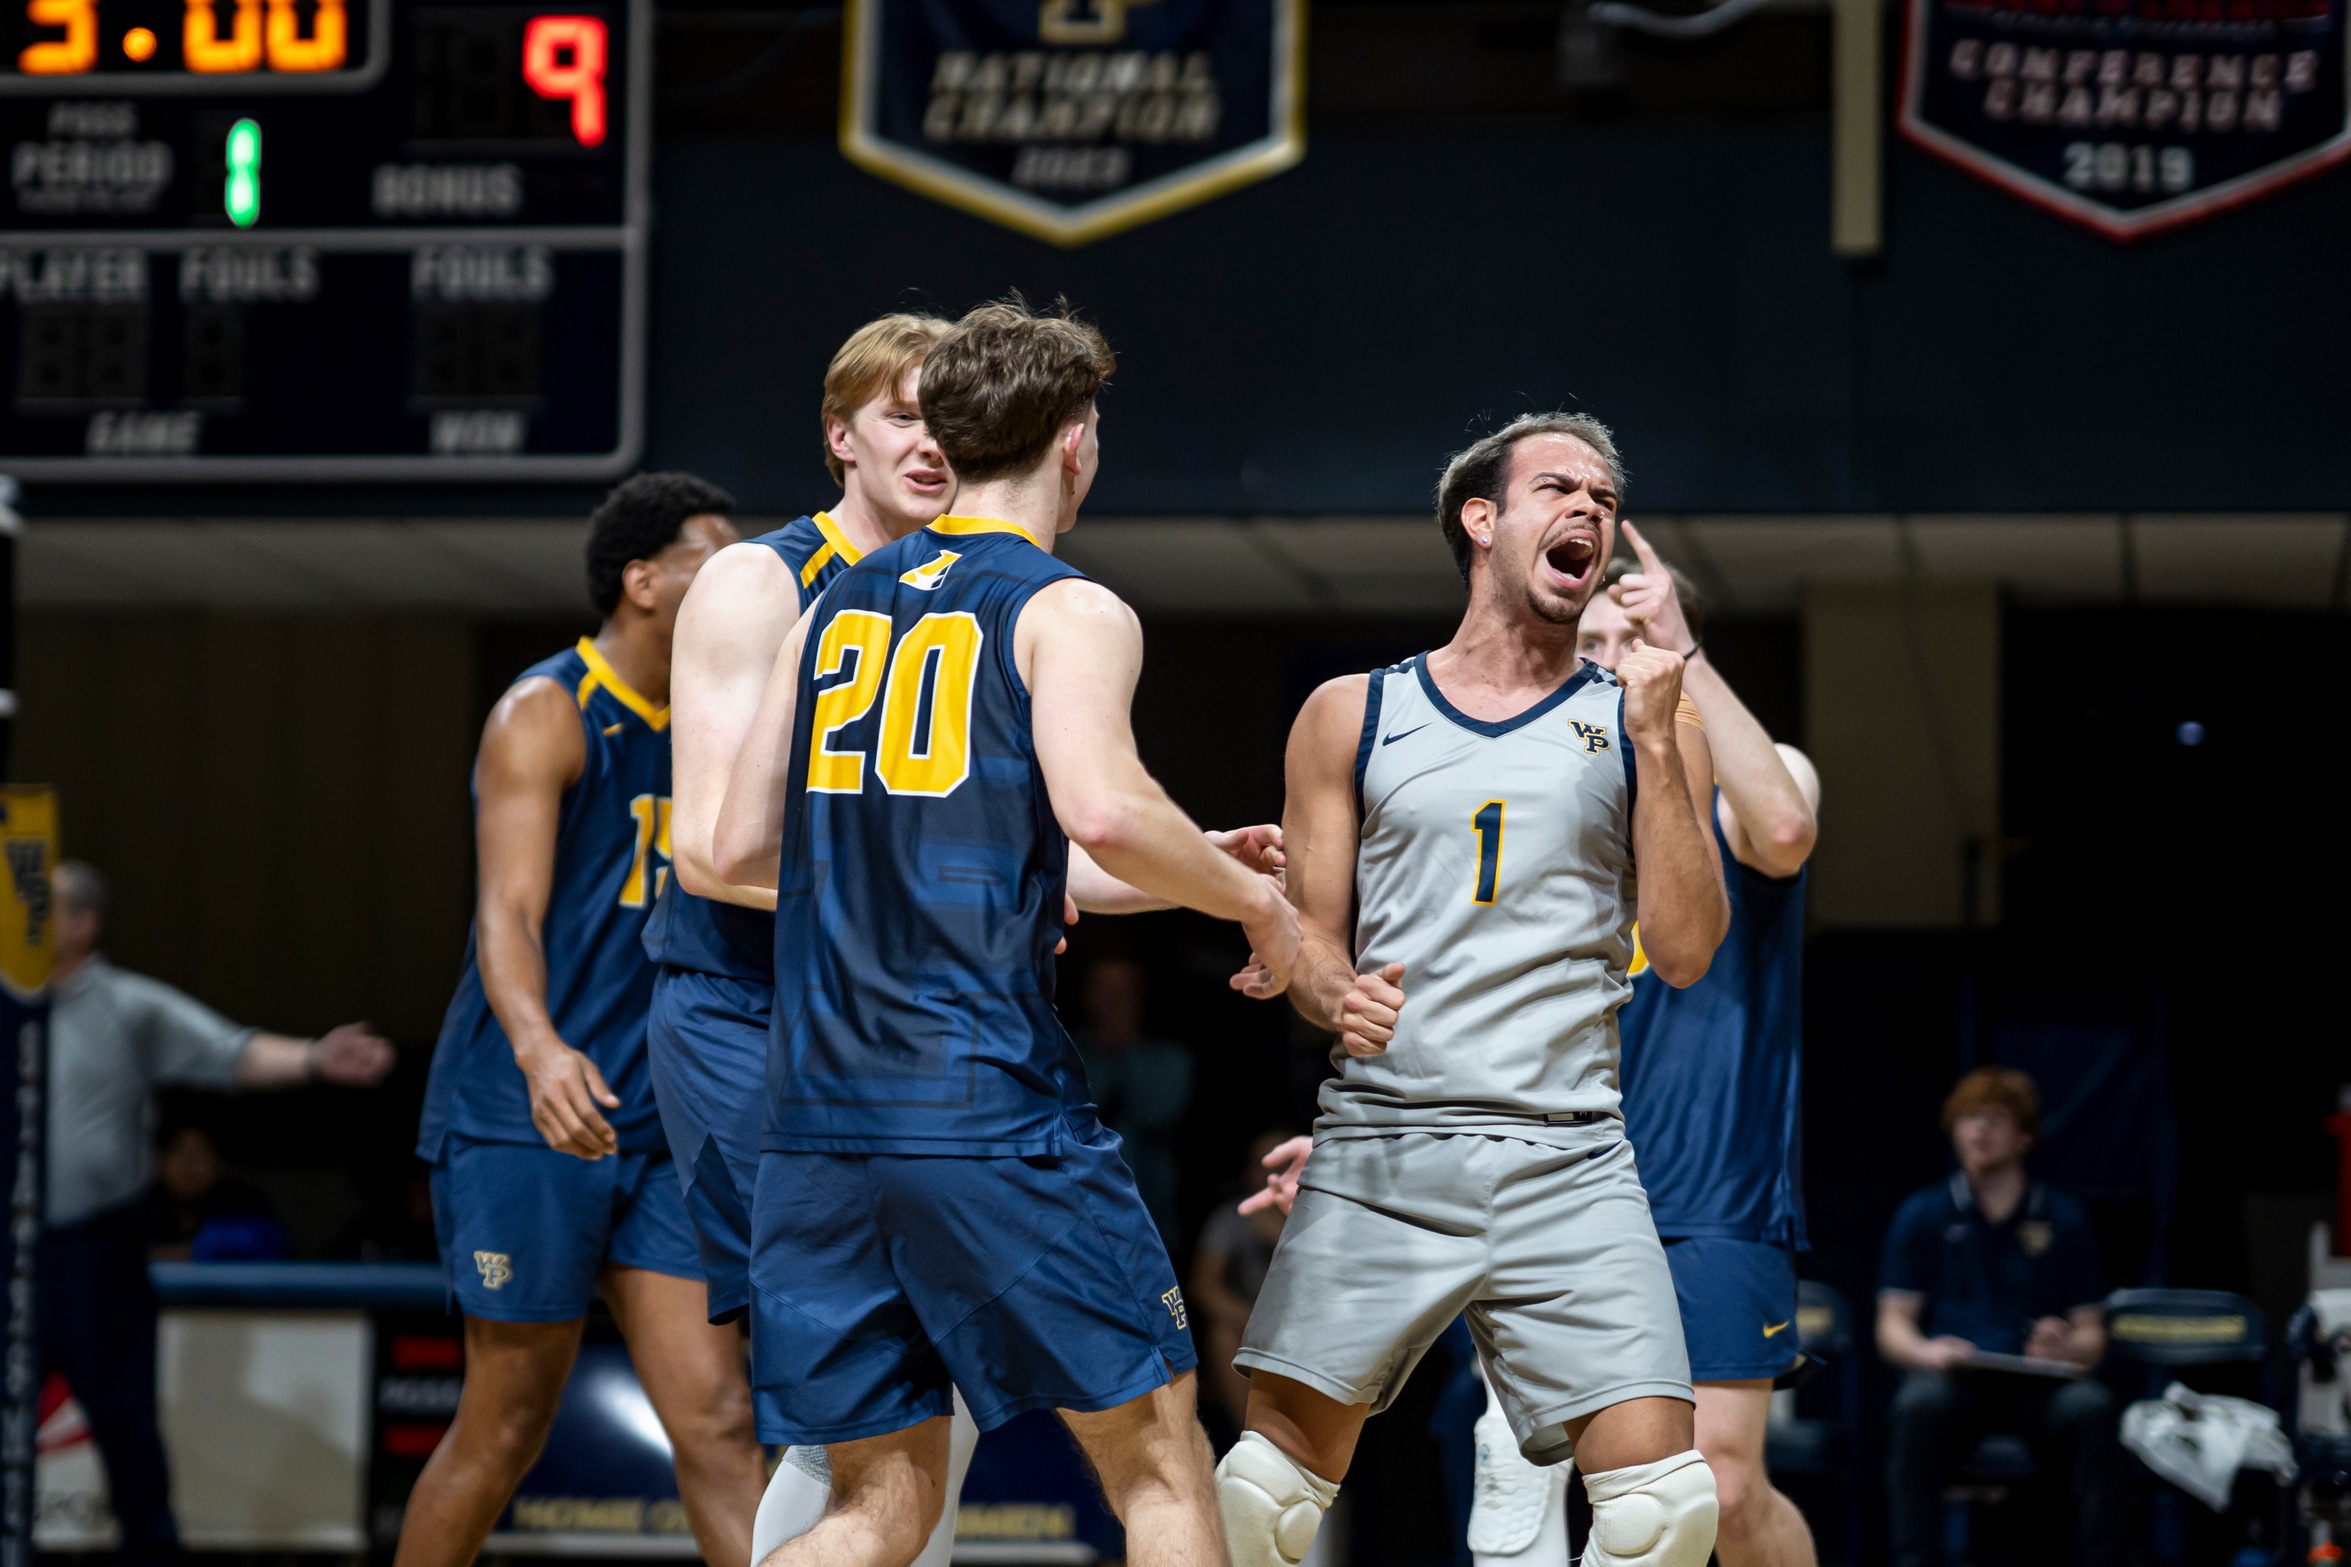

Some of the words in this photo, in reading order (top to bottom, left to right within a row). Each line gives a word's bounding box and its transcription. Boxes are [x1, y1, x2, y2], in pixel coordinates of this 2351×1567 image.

[521, 13, 608, 149] 9
[928, 50, 1216, 96] NATIONAL
[1948, 37, 2319, 95] CONFERENCE
[922, 96, 1222, 142] CHAMPION
[1982, 80, 2284, 135] CHAMPION
[11, 139, 177, 194] PERIOD
[225, 118, 262, 228] 1
[370, 162, 524, 218] BONUS
[2061, 142, 2197, 195] 2019
[0, 250, 148, 302] PLAYER
[177, 250, 320, 302] FOULS
[409, 250, 555, 302] FOULS
[84, 411, 202, 453] GAME
[806, 609, 984, 798] 20
[1471, 799, 1505, 906] 1
